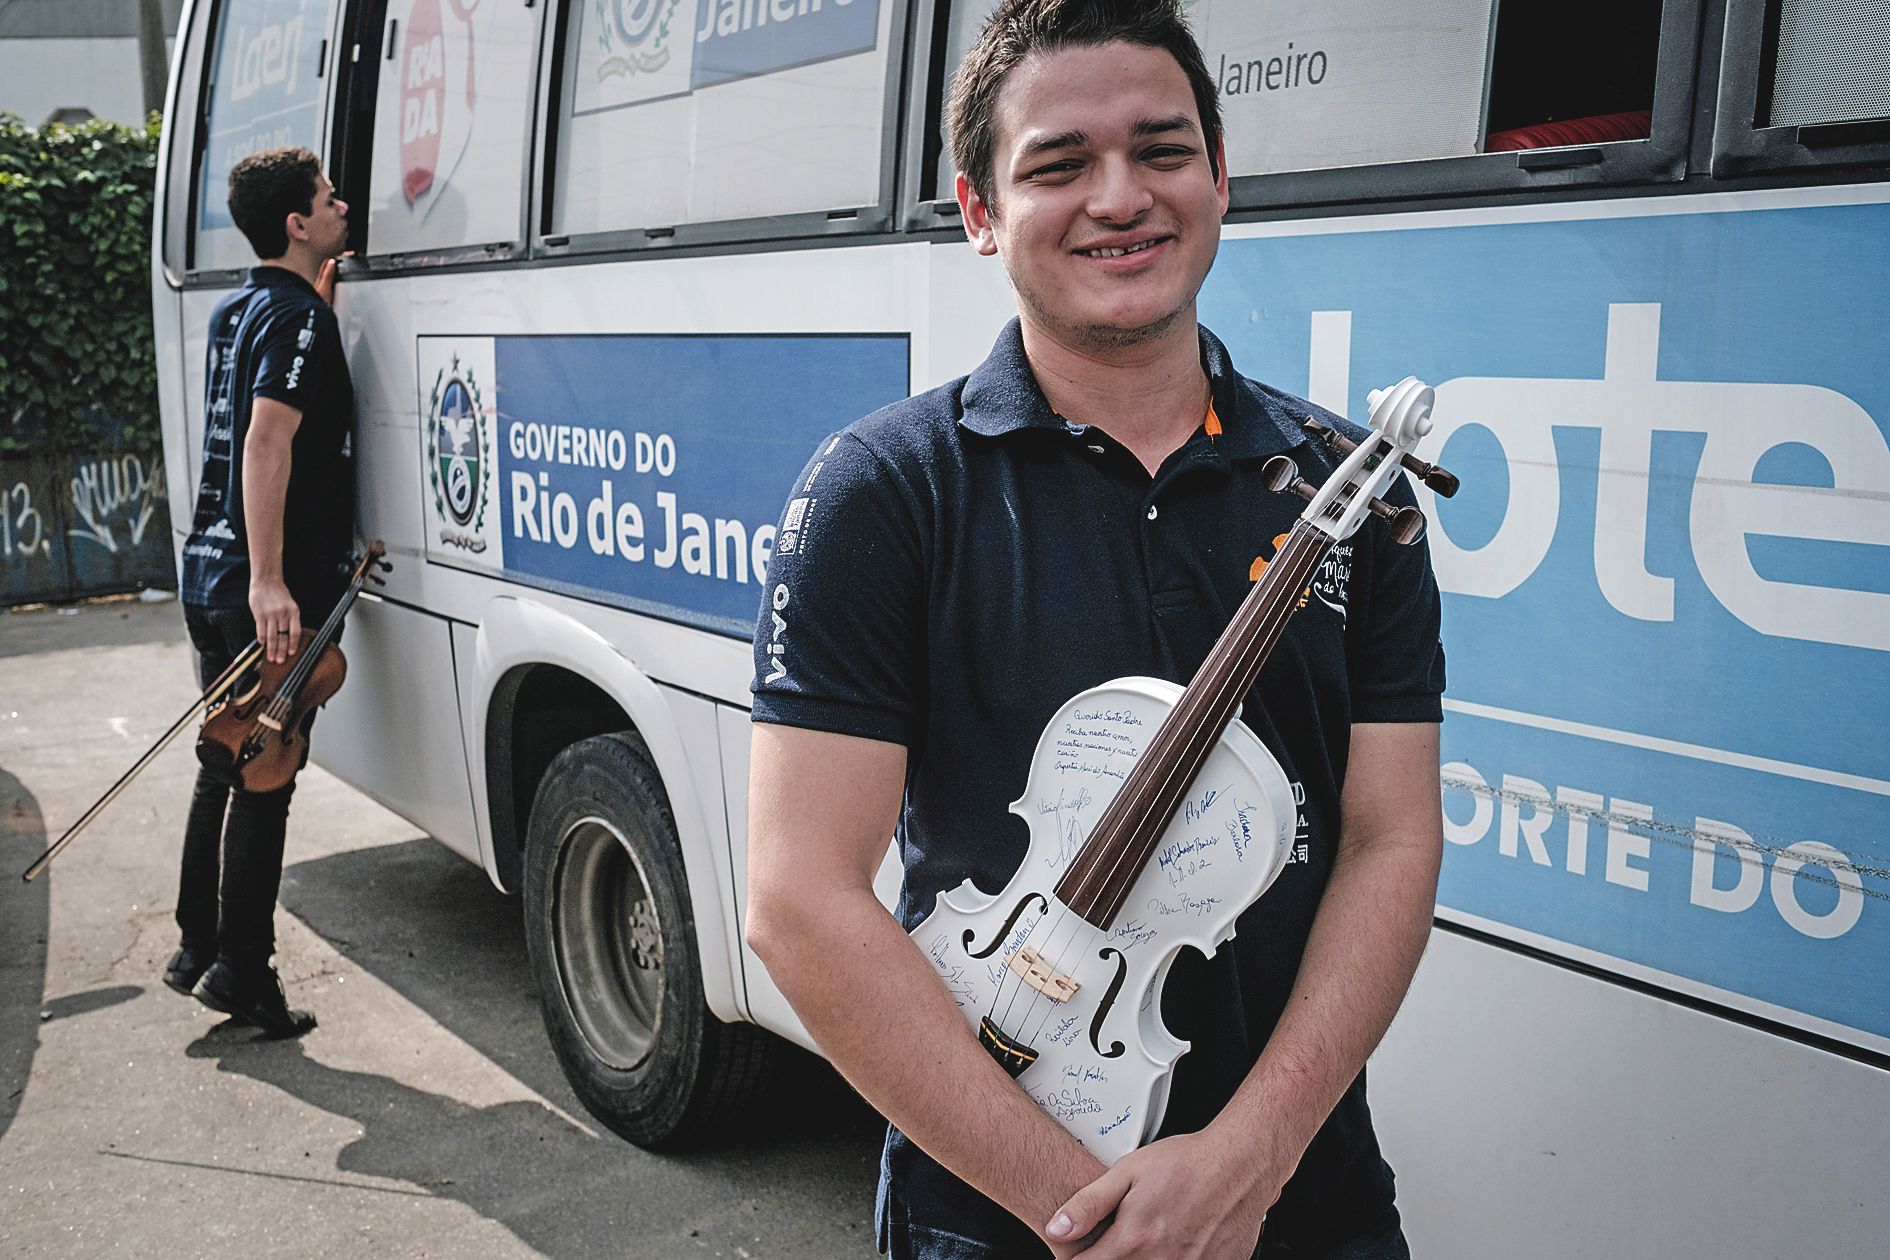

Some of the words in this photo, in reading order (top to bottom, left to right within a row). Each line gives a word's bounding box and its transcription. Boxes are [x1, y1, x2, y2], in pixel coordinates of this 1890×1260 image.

[509, 421, 627, 471] GOVERNO
[635, 432, 676, 477] DO
[511, 470, 578, 549] Rio
[587, 480, 644, 562] de
[764, 583, 790, 684] vivo
[1690, 815, 1864, 939] DO
